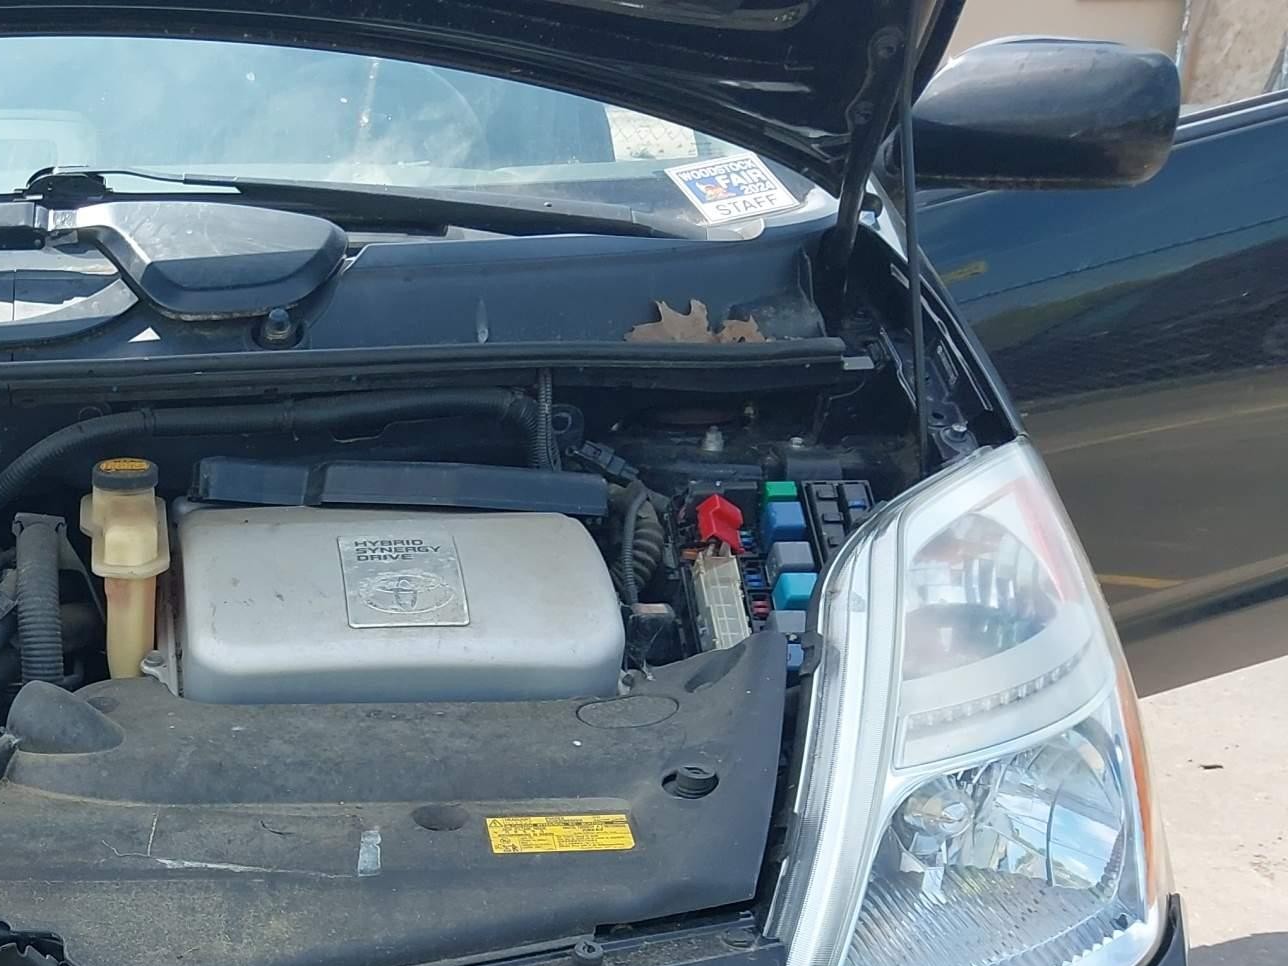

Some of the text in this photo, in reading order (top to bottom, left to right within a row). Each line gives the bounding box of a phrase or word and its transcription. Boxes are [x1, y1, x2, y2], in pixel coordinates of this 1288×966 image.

[679, 159, 756, 182] WOODSTOCK
[715, 169, 765, 189] FAIR
[741, 181, 774, 195] 2024
[716, 194, 777, 216] STAFF
[354, 539, 423, 547] HYBRID
[355, 546, 441, 554] SYNERGY
[357, 553, 414, 562] DRIVE
